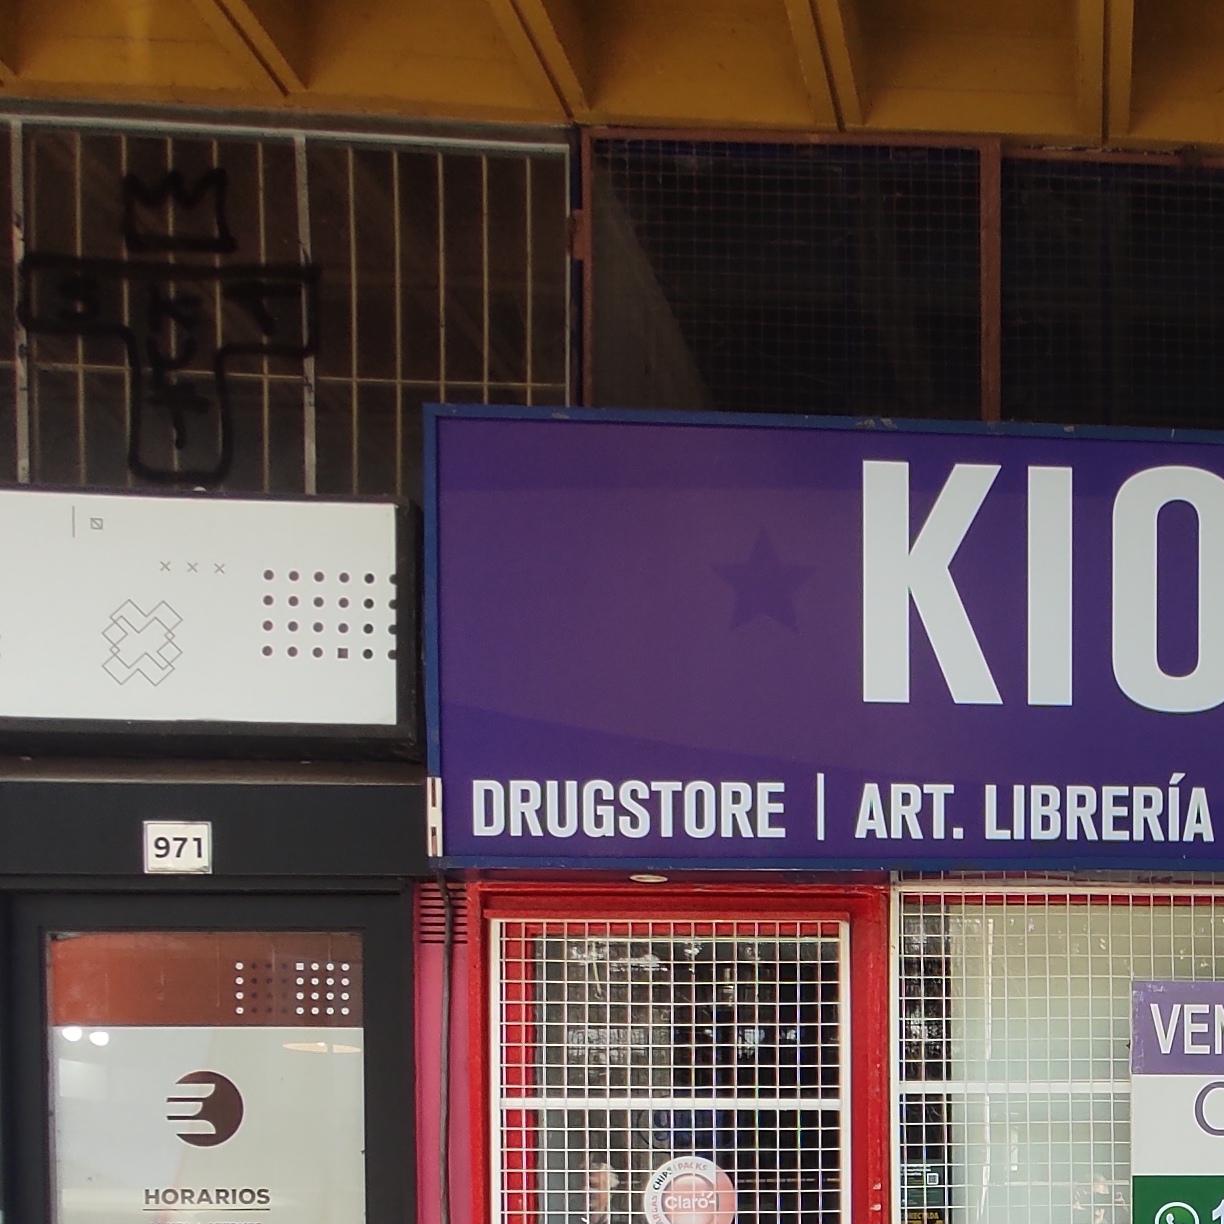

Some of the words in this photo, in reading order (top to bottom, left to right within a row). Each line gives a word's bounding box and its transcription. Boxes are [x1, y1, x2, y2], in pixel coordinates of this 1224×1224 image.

[472, 779, 787, 839] DRUGSTORE
[854, 782, 965, 841] ART.
[984, 772, 1216, 843] LIBRERÍA
[153, 836, 203, 859] 971
[143, 1188, 271, 1205] HORARIOS
